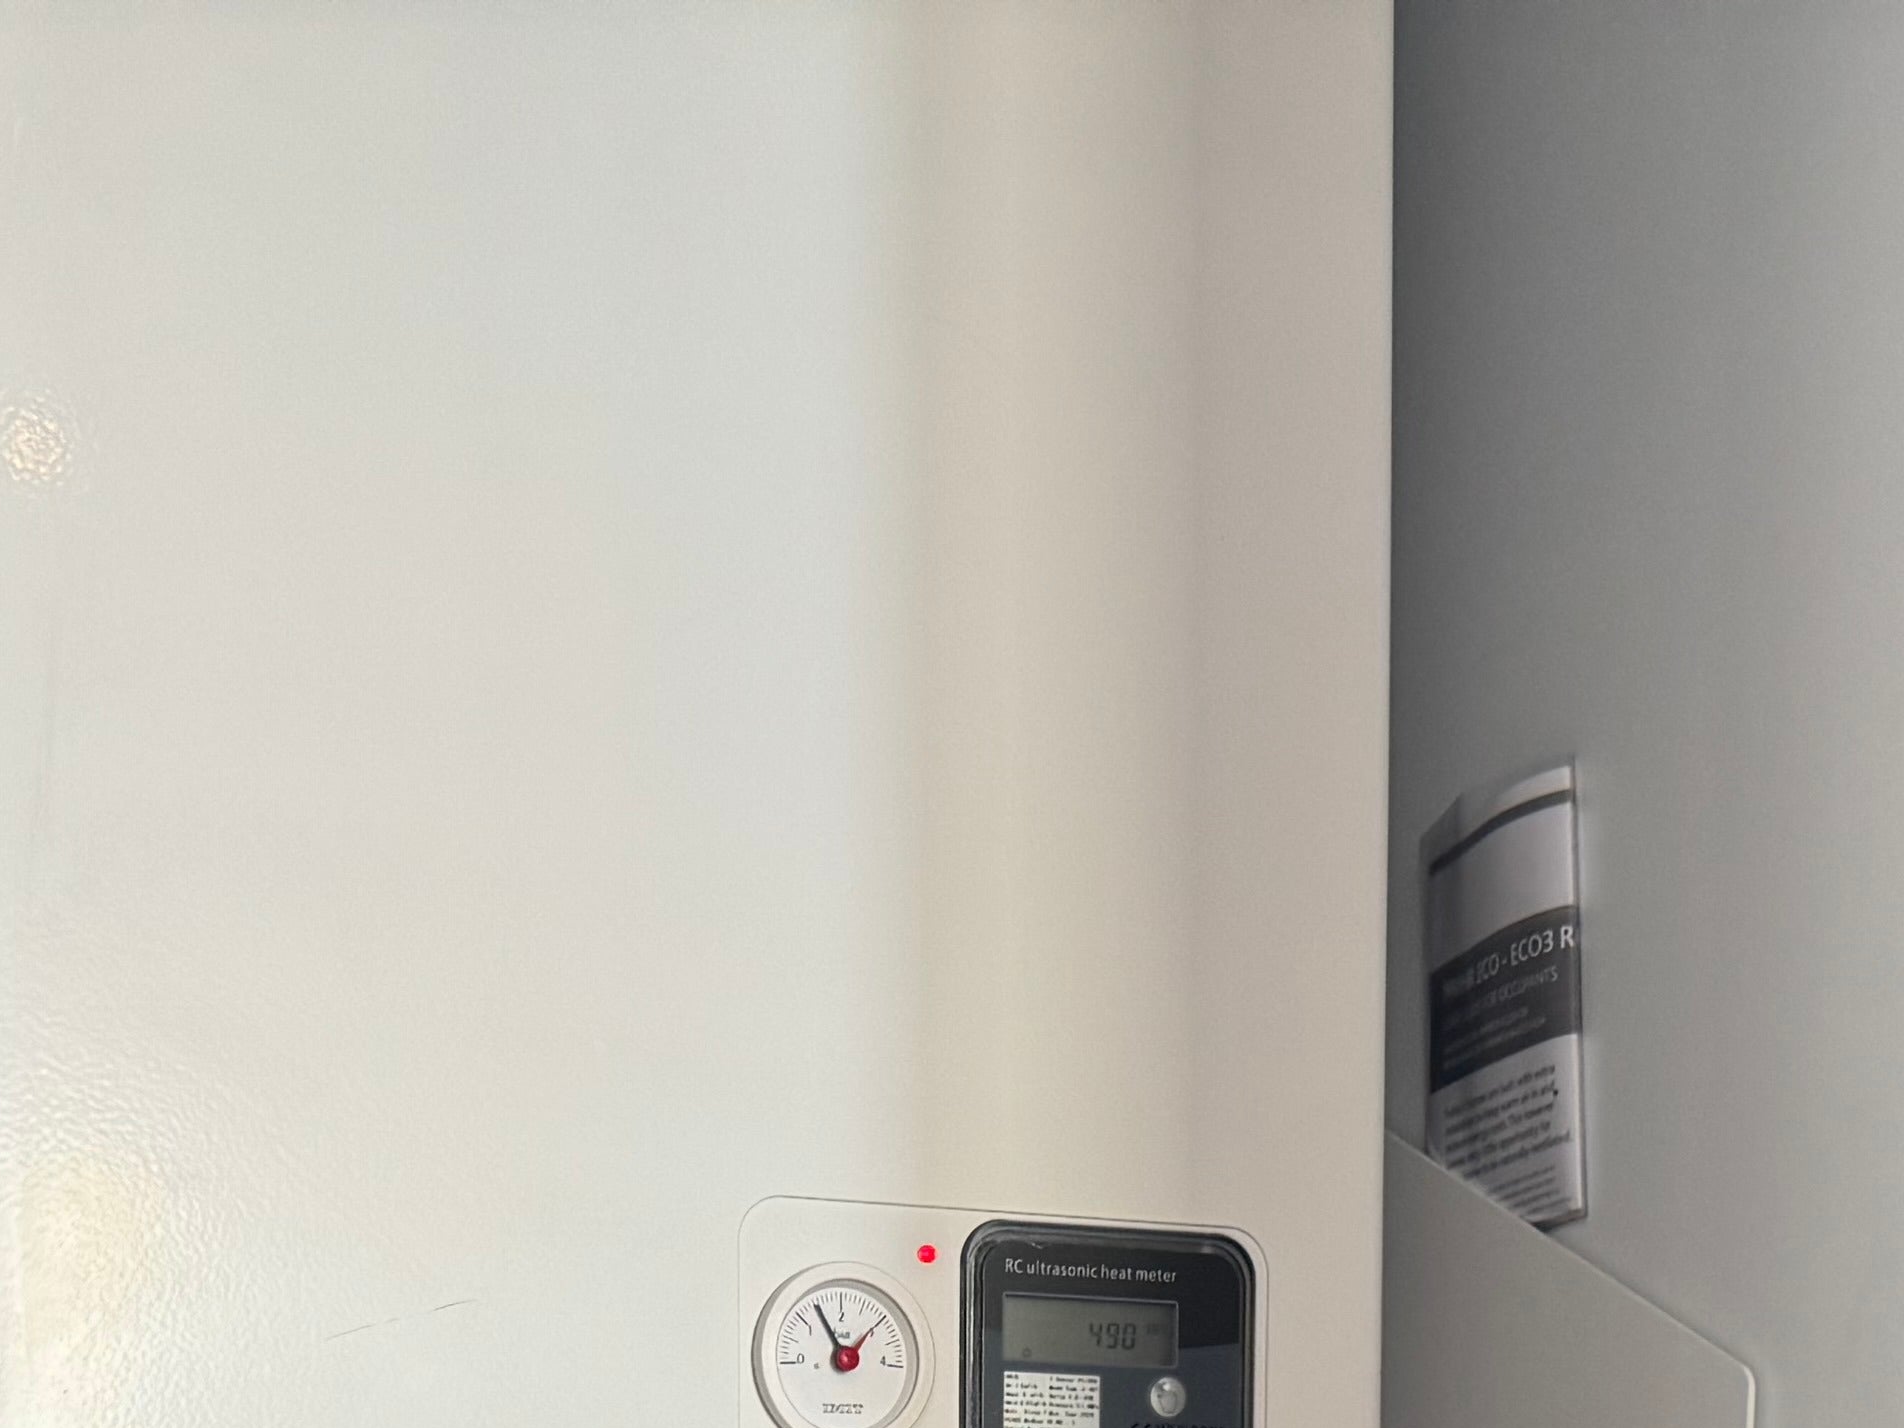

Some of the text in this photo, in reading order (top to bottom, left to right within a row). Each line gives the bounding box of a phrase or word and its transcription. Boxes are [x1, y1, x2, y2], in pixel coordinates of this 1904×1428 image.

[1510, 929, 1554, 966] ECO3
[1005, 1258, 1177, 1283] RC ultrasonic heat meter
[1089, 1322, 1137, 1350] 490
